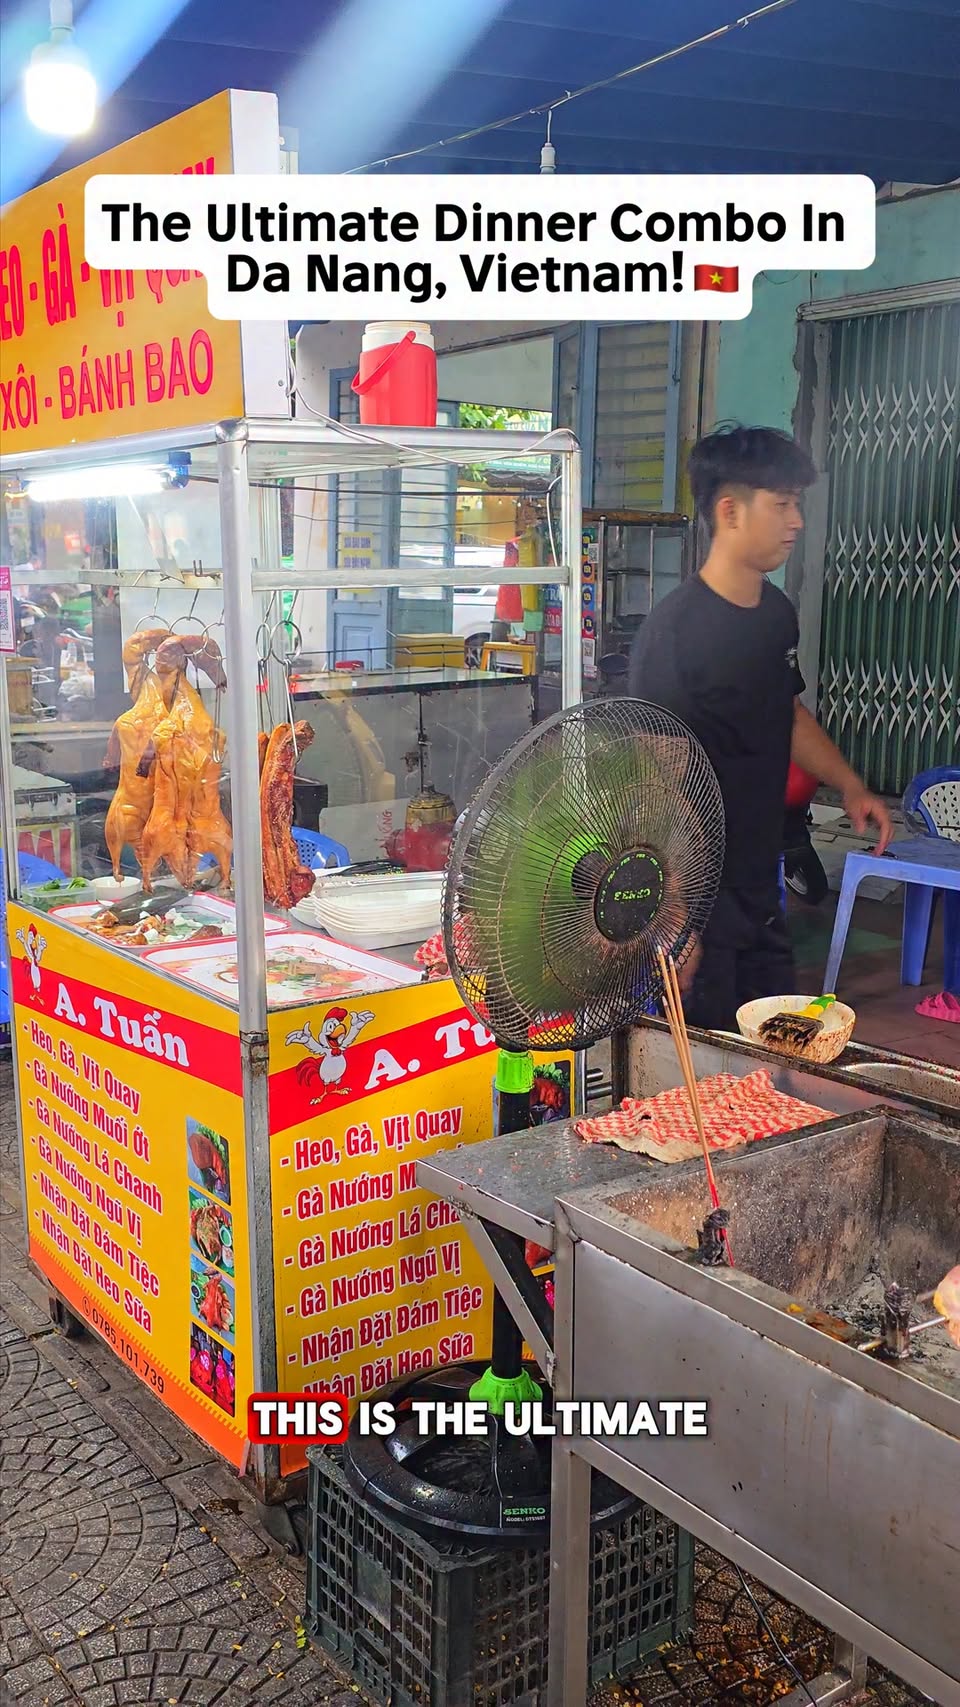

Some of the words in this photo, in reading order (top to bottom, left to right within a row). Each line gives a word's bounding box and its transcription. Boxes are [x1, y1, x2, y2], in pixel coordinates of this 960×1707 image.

[0, 245, 24, 340] EO
[42, 203, 76, 326] GÀ
[0, 363, 38, 431] XÔI
[58, 345, 135, 420] BÁNH
[144, 329, 213, 403] BAO
[31, 1020, 56, 1059] Heo,
[60, 1040, 79, 1075] Gà,
[82, 1054, 100, 1090] Vịt
[104, 1069, 140, 1114] Quay
[54, 982, 86, 1026] A.
[93, 996, 190, 1067] Tuấn
[34, 1059, 48, 1088] Gà
[51, 1071, 88, 1122] Nướng
[93, 1102, 128, 1147] Muối
[133, 1126, 149, 1162] Ớt
[364, 1049, 420, 1090] A.
[37, 1098, 50, 1126] Gà
[53, 1111, 90, 1162] Nướng
[94, 1143, 109, 1175] Lá
[114, 1159, 162, 1214] Chanh
[296, 1138, 339, 1170] Heo,
[346, 1124, 378, 1156] Gà,
[384, 1116, 410, 1150] Vịt
[415, 1107, 462, 1141] Quay
[39, 1135, 52, 1164] Gà
[55, 1149, 92, 1203] Nướng
[96, 1184, 122, 1226] Ngũ
[127, 1208, 141, 1246] Vị
[297, 1187, 323, 1219] Gà
[330, 1172, 392, 1210] Nướng
[40, 1172, 68, 1216] Nhận
[71, 1201, 91, 1238] Đặt
[93, 1222, 124, 1267] Đám
[128, 1250, 159, 1296] Tiệc
[42, 1210, 70, 1254] Nhận
[73, 1240, 92, 1277] Đặt
[95, 1262, 120, 1303] Heo
[124, 1289, 152, 1333] Sữa
[300, 1236, 325, 1268] Gà
[331, 1220, 393, 1259] Nướng
[400, 1208, 420, 1238] Lá
[427, 1201, 460, 1229] Cha
[301, 1285, 326, 1317] Gà
[333, 1269, 394, 1307] Nướng
[400, 1249, 436, 1285] Ngũ
[442, 1242, 460, 1275] Vị
[93, 1308, 164, 1394] 0785.101.739
[302, 1327, 354, 1366] Nhận
[360, 1313, 392, 1347] Đặt
[397, 1300, 438, 1333] Đám
[444, 1286, 482, 1318] Tiệc
[438, 1333, 473, 1364] Sữa
[503, 1507, 546, 1515] SENKO
